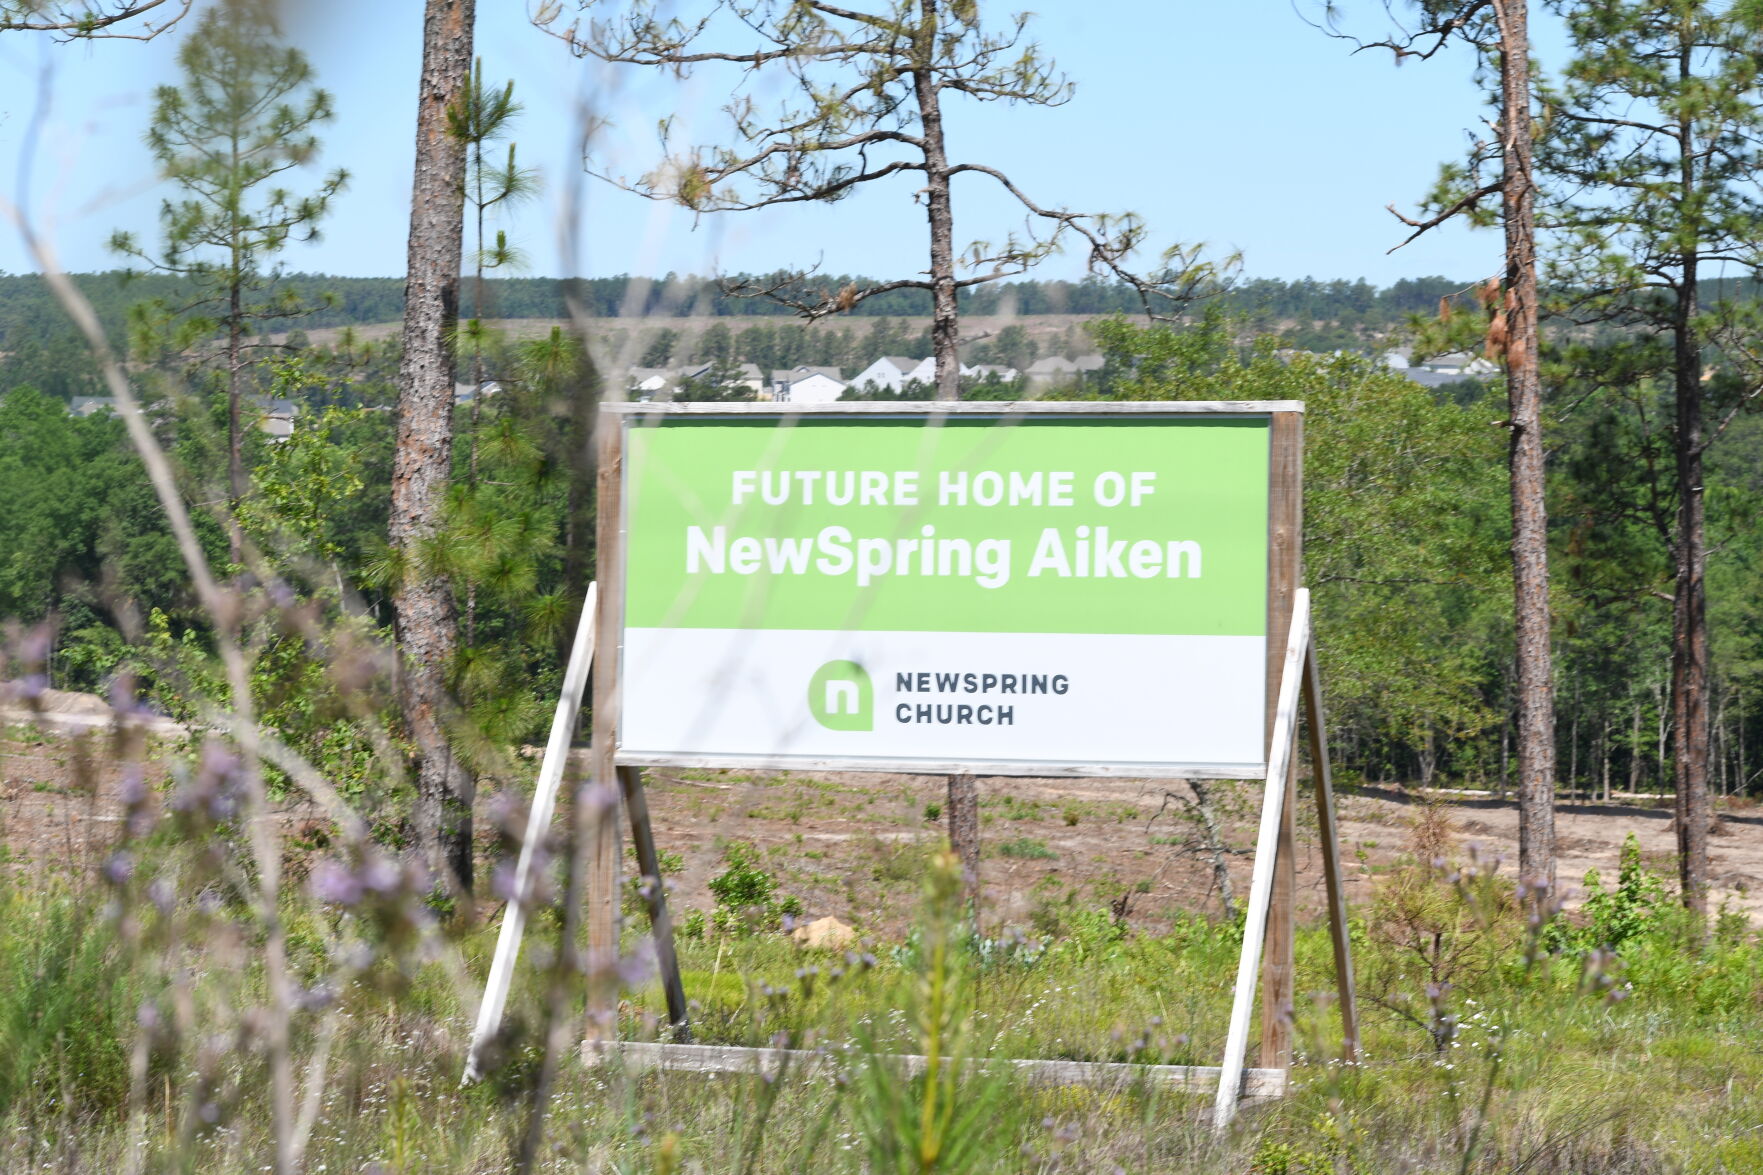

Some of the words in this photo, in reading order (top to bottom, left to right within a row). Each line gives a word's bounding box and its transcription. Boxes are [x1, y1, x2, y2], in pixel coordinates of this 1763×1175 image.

[731, 470, 919, 506] FUTURE
[938, 470, 1075, 507] HOME
[1093, 471, 1157, 507] OF
[686, 525, 1012, 589] NewSpring
[1028, 526, 1202, 579] Aiken
[895, 671, 1070, 696] NEWSPRING
[895, 703, 1015, 726] CHURCH
